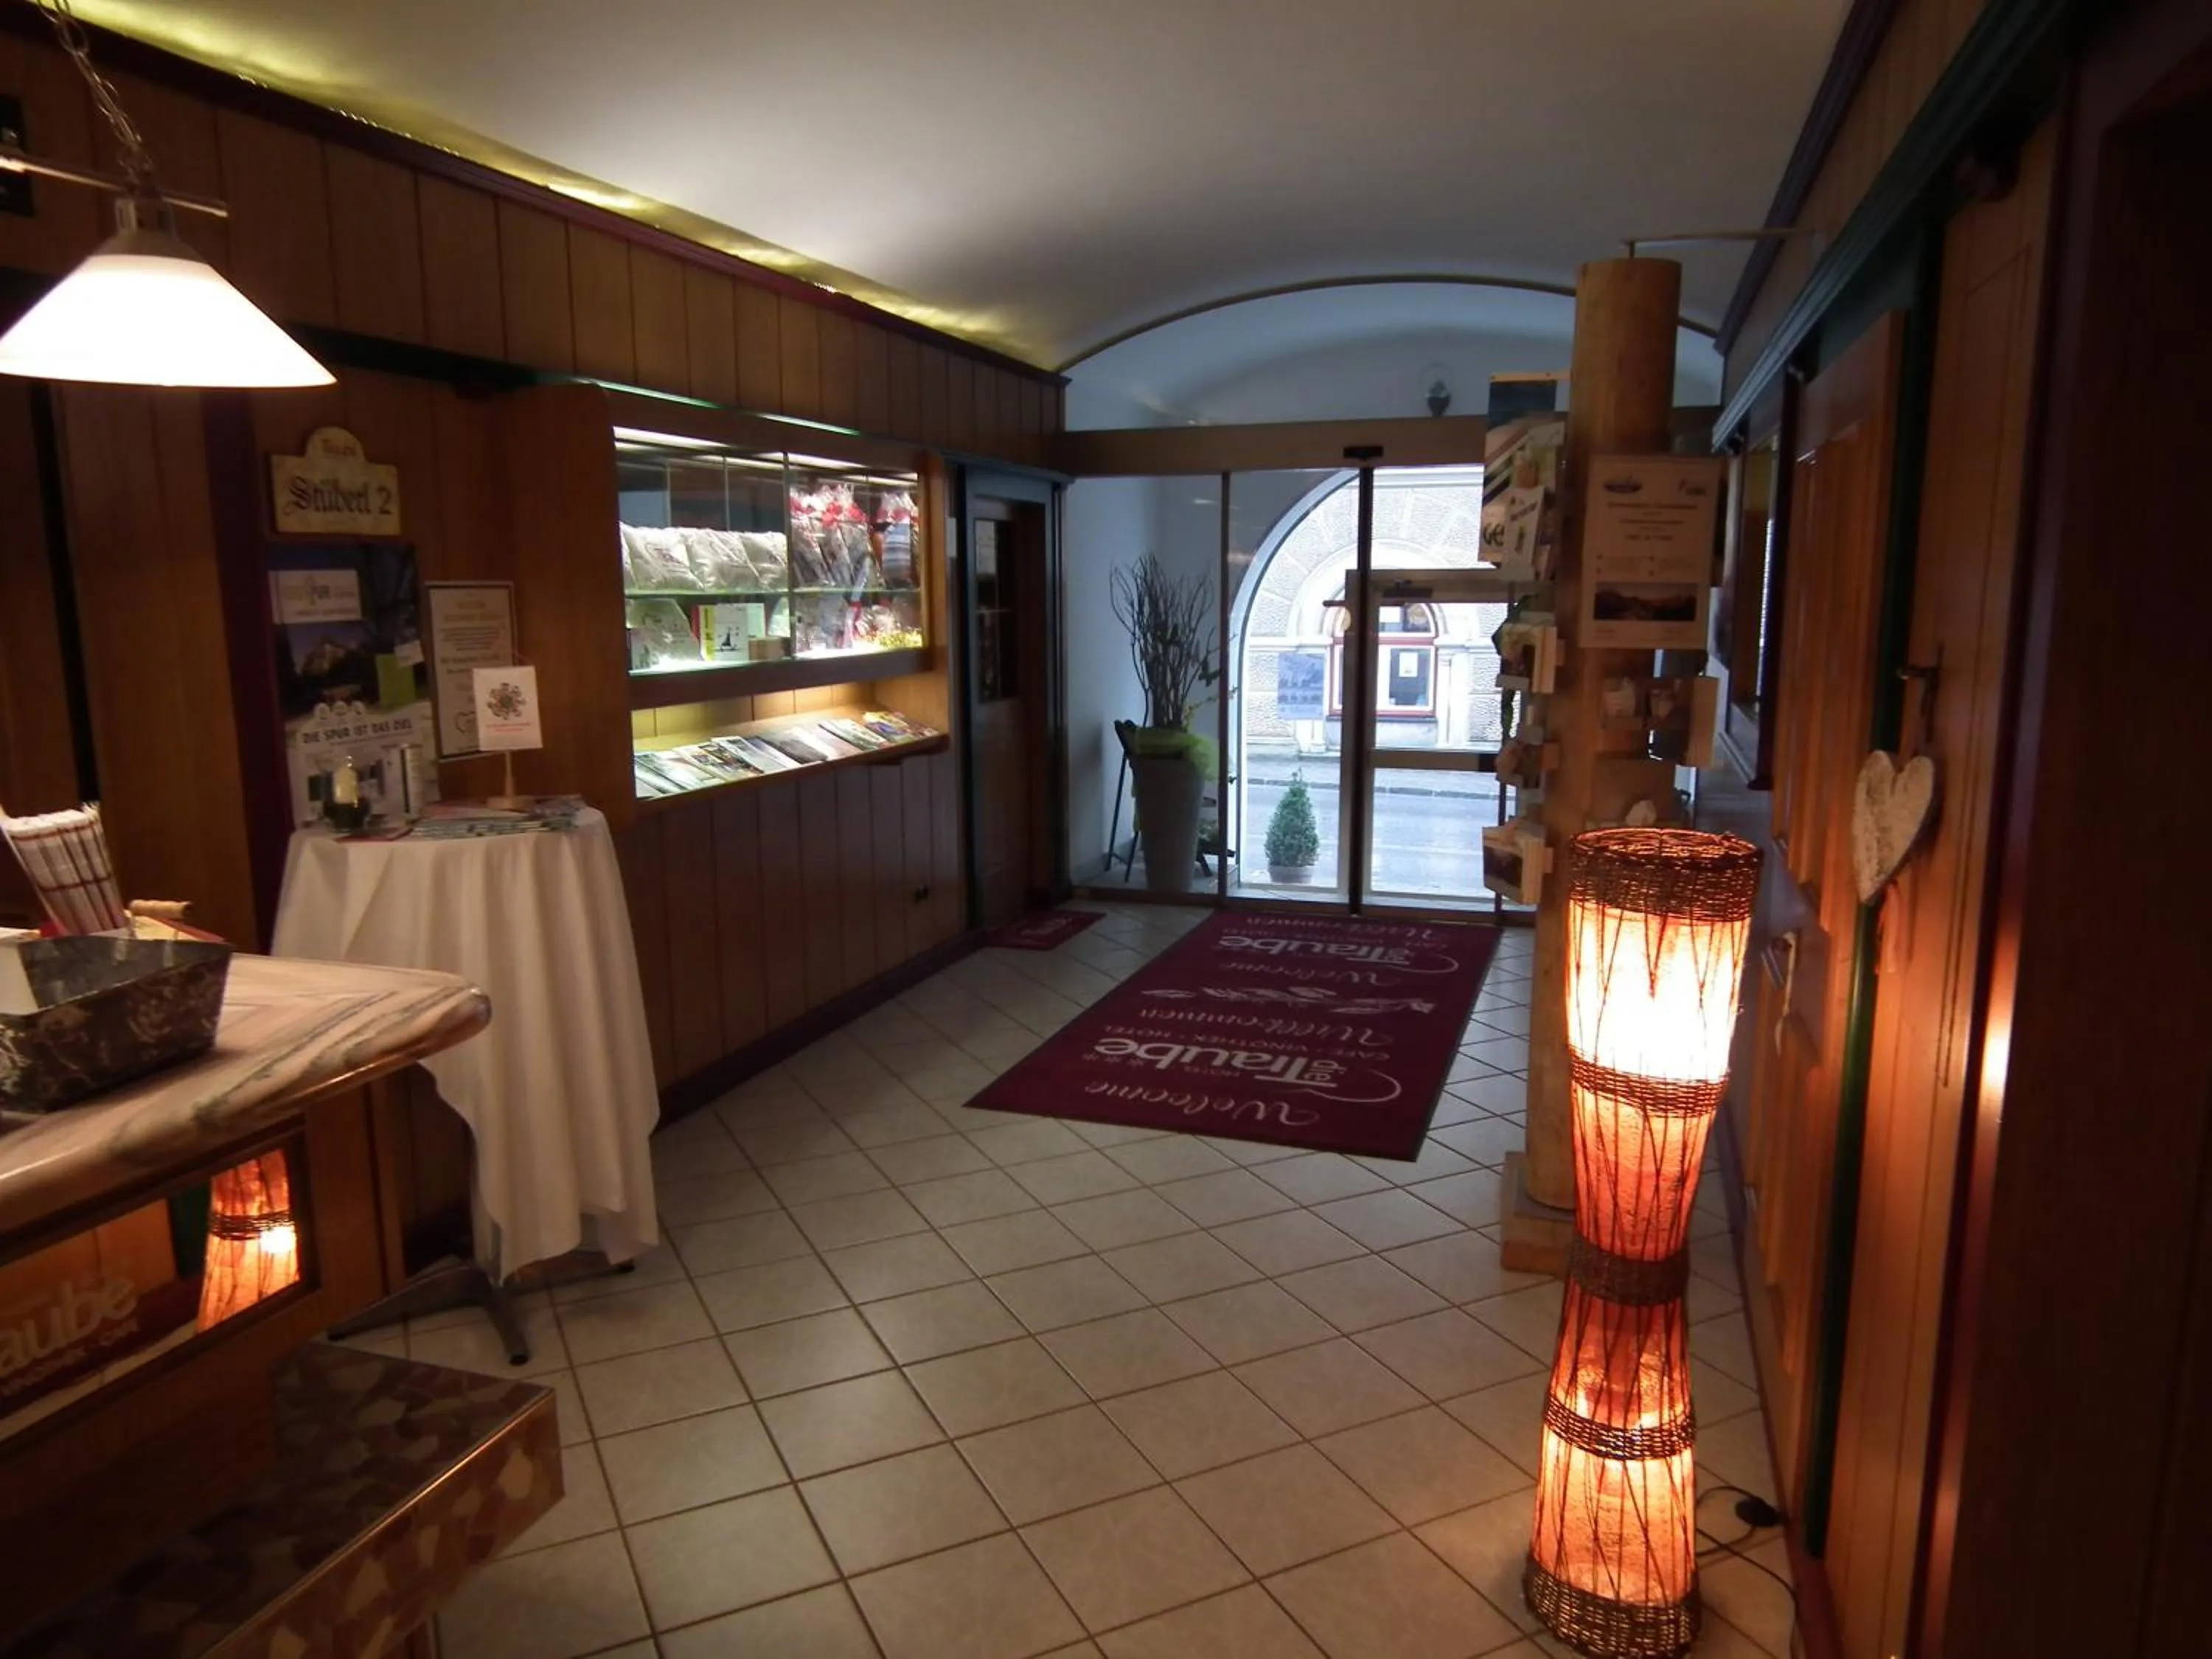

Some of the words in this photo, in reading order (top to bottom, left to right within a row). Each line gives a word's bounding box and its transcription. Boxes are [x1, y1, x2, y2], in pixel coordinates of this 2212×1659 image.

[282, 474, 371, 516] Stüberl
[377, 484, 394, 515] 2
[1218, 934, 1411, 966] Traube
[1101, 1023, 1172, 1040] HOTEL
[1138, 1008, 1395, 1046] Willkommen
[1192, 1033, 1310, 1053] VINOTHEK
[1092, 1037, 1340, 1088] Traube
[1303, 1058, 1348, 1082] die
[1083, 1079, 1321, 1127] Welcome
